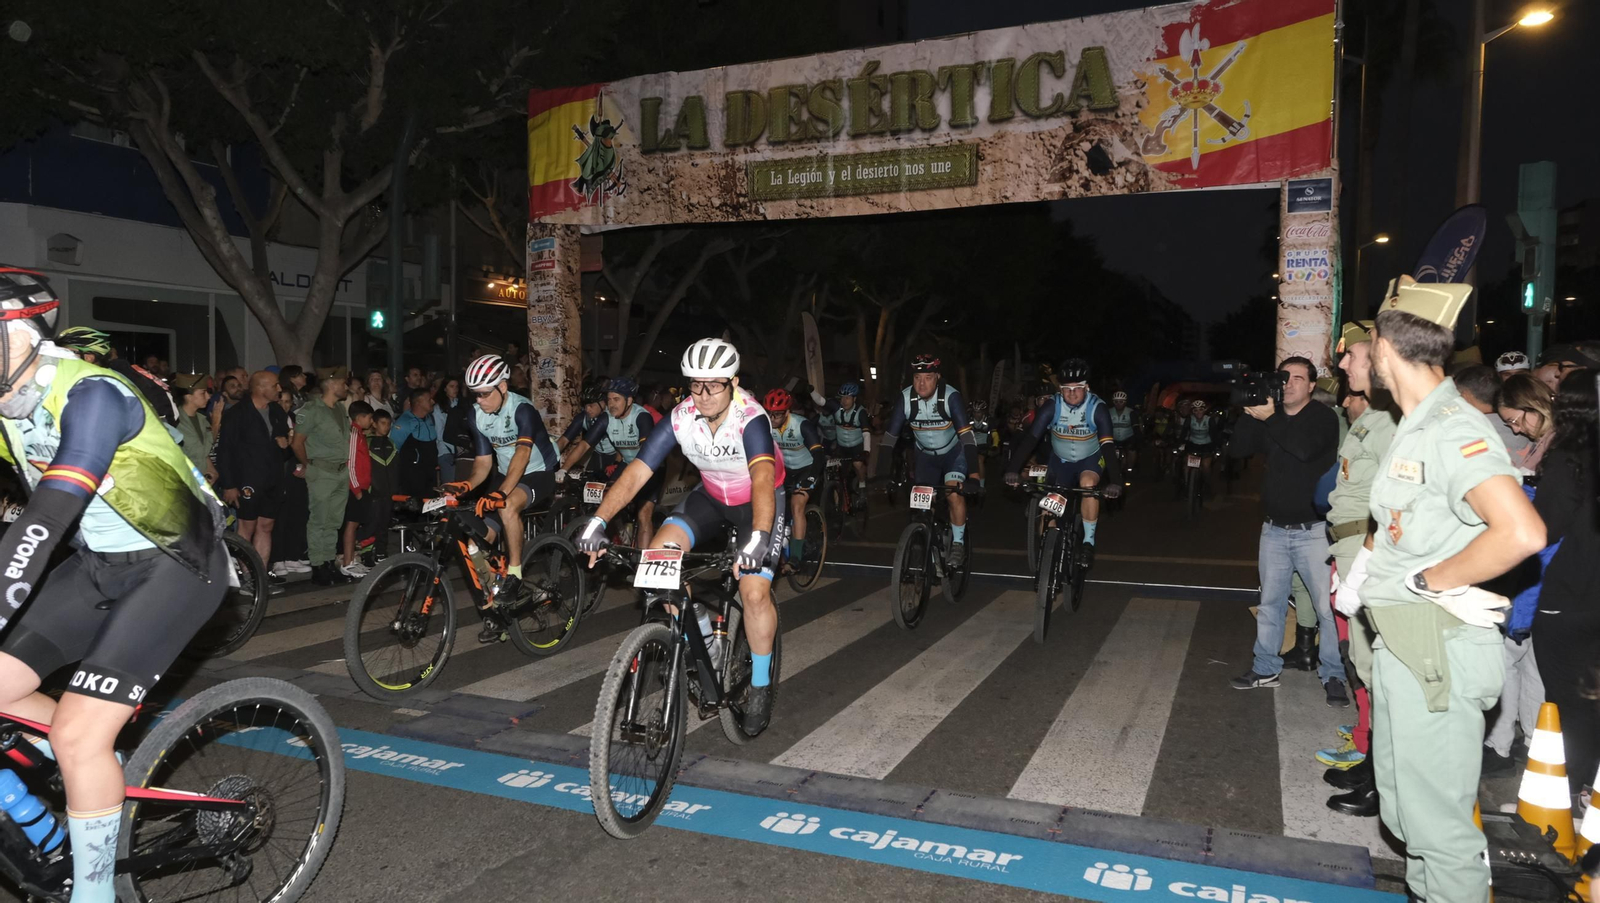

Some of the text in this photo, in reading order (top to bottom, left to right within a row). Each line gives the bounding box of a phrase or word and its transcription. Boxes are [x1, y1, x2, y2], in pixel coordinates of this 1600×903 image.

[640, 46, 1120, 153] LA DESÉRTICA
[770, 161, 951, 187] La Legión y el desierto nos une
[1286, 257, 1328, 268] RENTA
[1287, 249, 1328, 257] GRUPO
[913, 493, 930, 502] 8199
[1043, 497, 1064, 512] 6106
[4, 523, 50, 579] Orona
[644, 560, 677, 577] 7725
[340, 742, 465, 771] cajamar
[379, 760, 442, 776] CAJA RURAL
[828, 826, 1024, 867] cajamar
[913, 852, 1011, 874] CAJA RURAL
